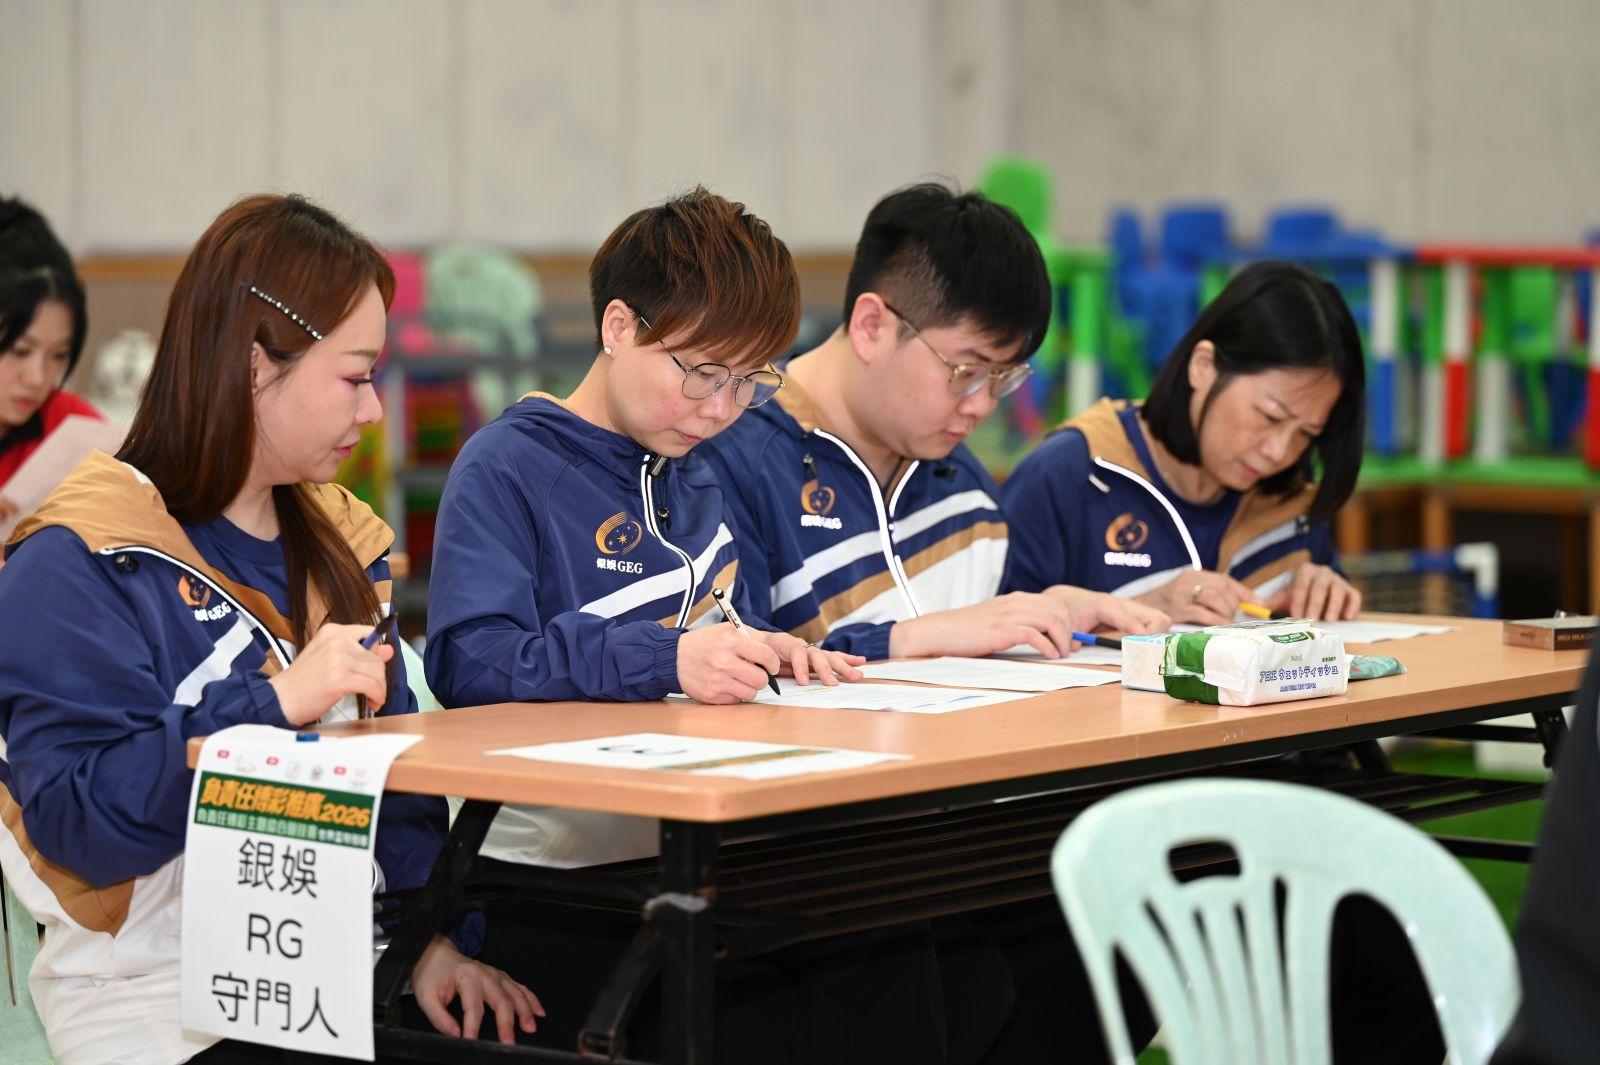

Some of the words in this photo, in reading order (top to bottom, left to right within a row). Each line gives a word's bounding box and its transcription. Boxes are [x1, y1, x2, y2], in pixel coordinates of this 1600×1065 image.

[237, 837, 318, 899] 銀娛
[247, 912, 303, 960] RG
[211, 971, 339, 1039] 守門人
